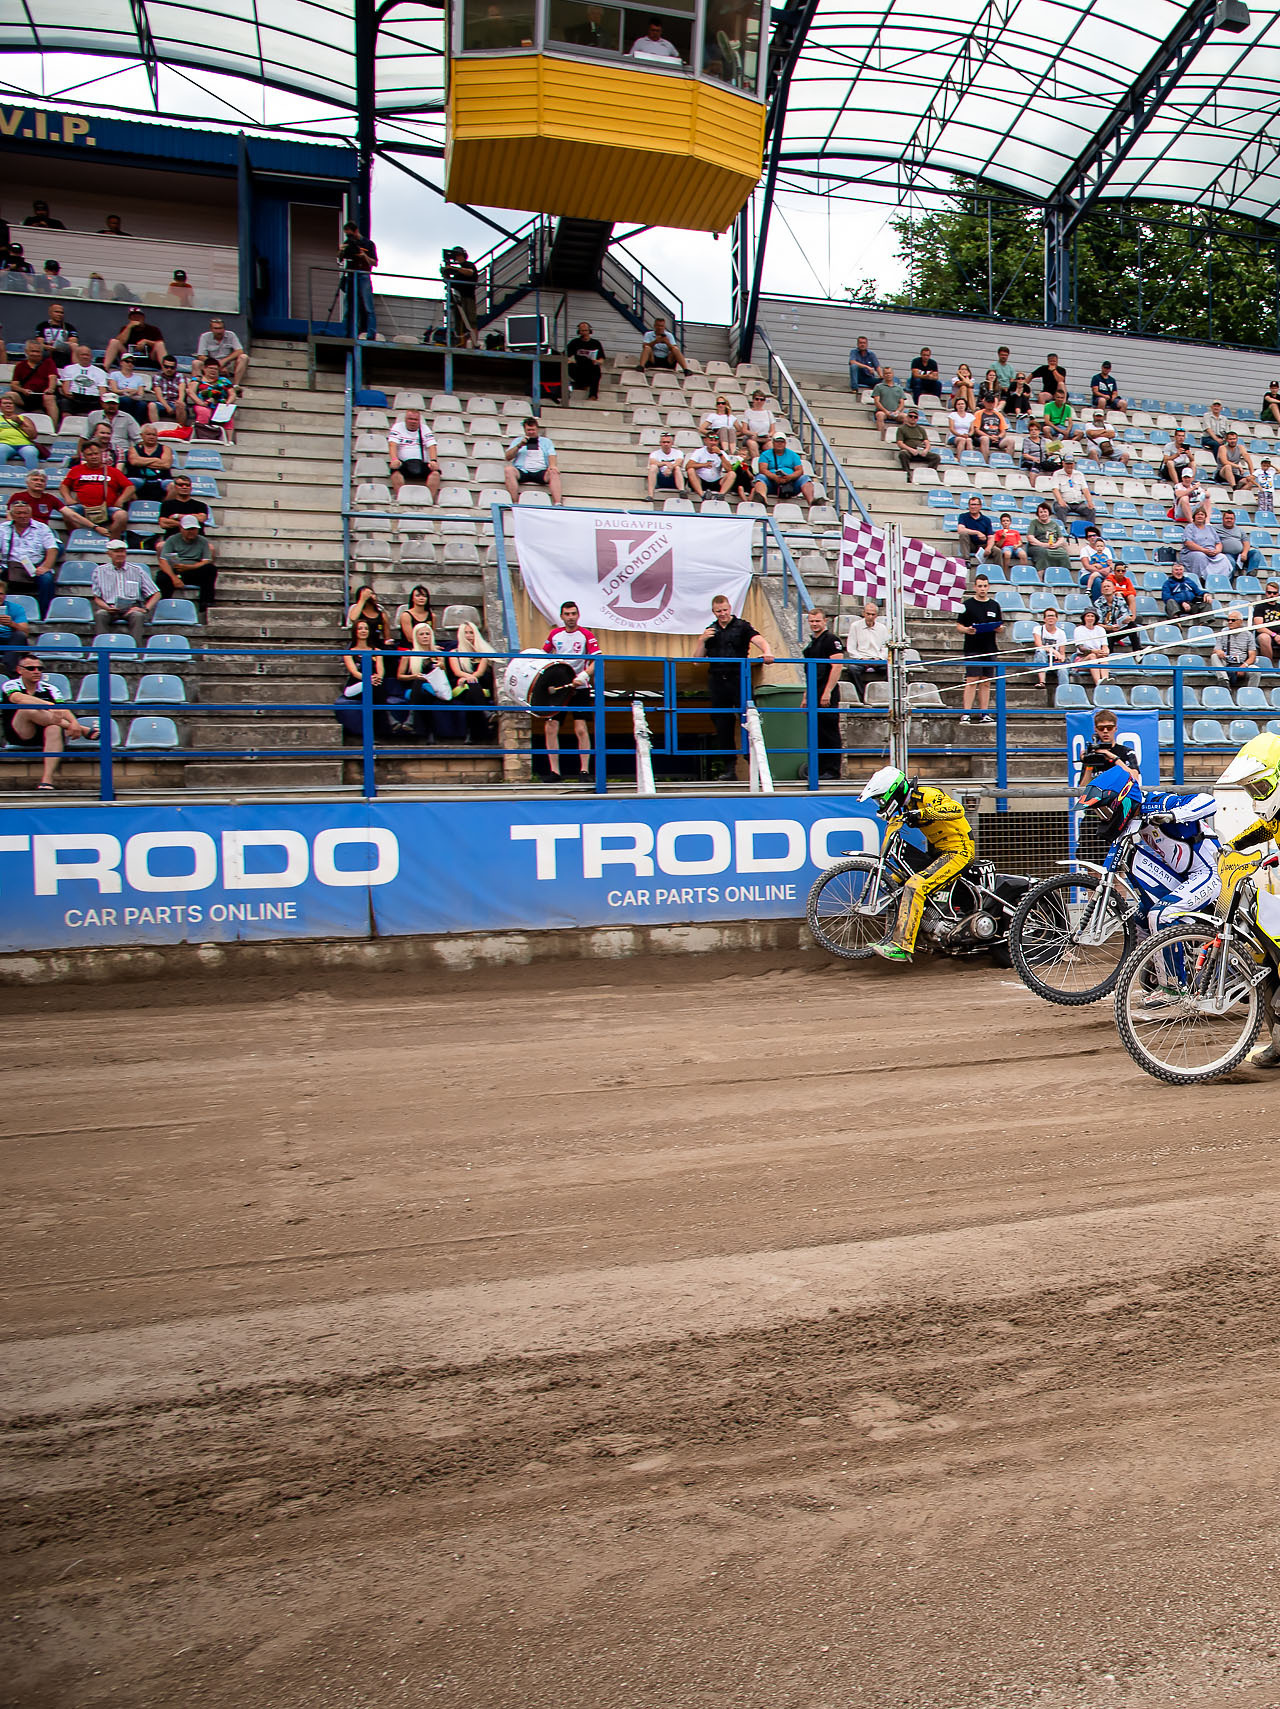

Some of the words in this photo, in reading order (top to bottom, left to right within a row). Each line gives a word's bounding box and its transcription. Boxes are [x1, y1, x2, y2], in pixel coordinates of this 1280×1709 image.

[0, 108, 96, 146] V.I.P.
[595, 519, 673, 530] DAUGAVPILS
[602, 534, 669, 596] LOKOMOTIV
[600, 606, 648, 629] SPEEDWAY
[654, 607, 675, 626] CLUB
[0, 827, 400, 896] RODO
[510, 819, 881, 881] TRODO
[1141, 858, 1173, 883] SAGARI
[607, 889, 650, 907] CAR
[655, 887, 719, 905] PARTS
[724, 884, 796, 903] ONLINE
[65, 909, 117, 928] CAR
[124, 905, 202, 925] PARTS
[209, 901, 297, 922] ONLINE
